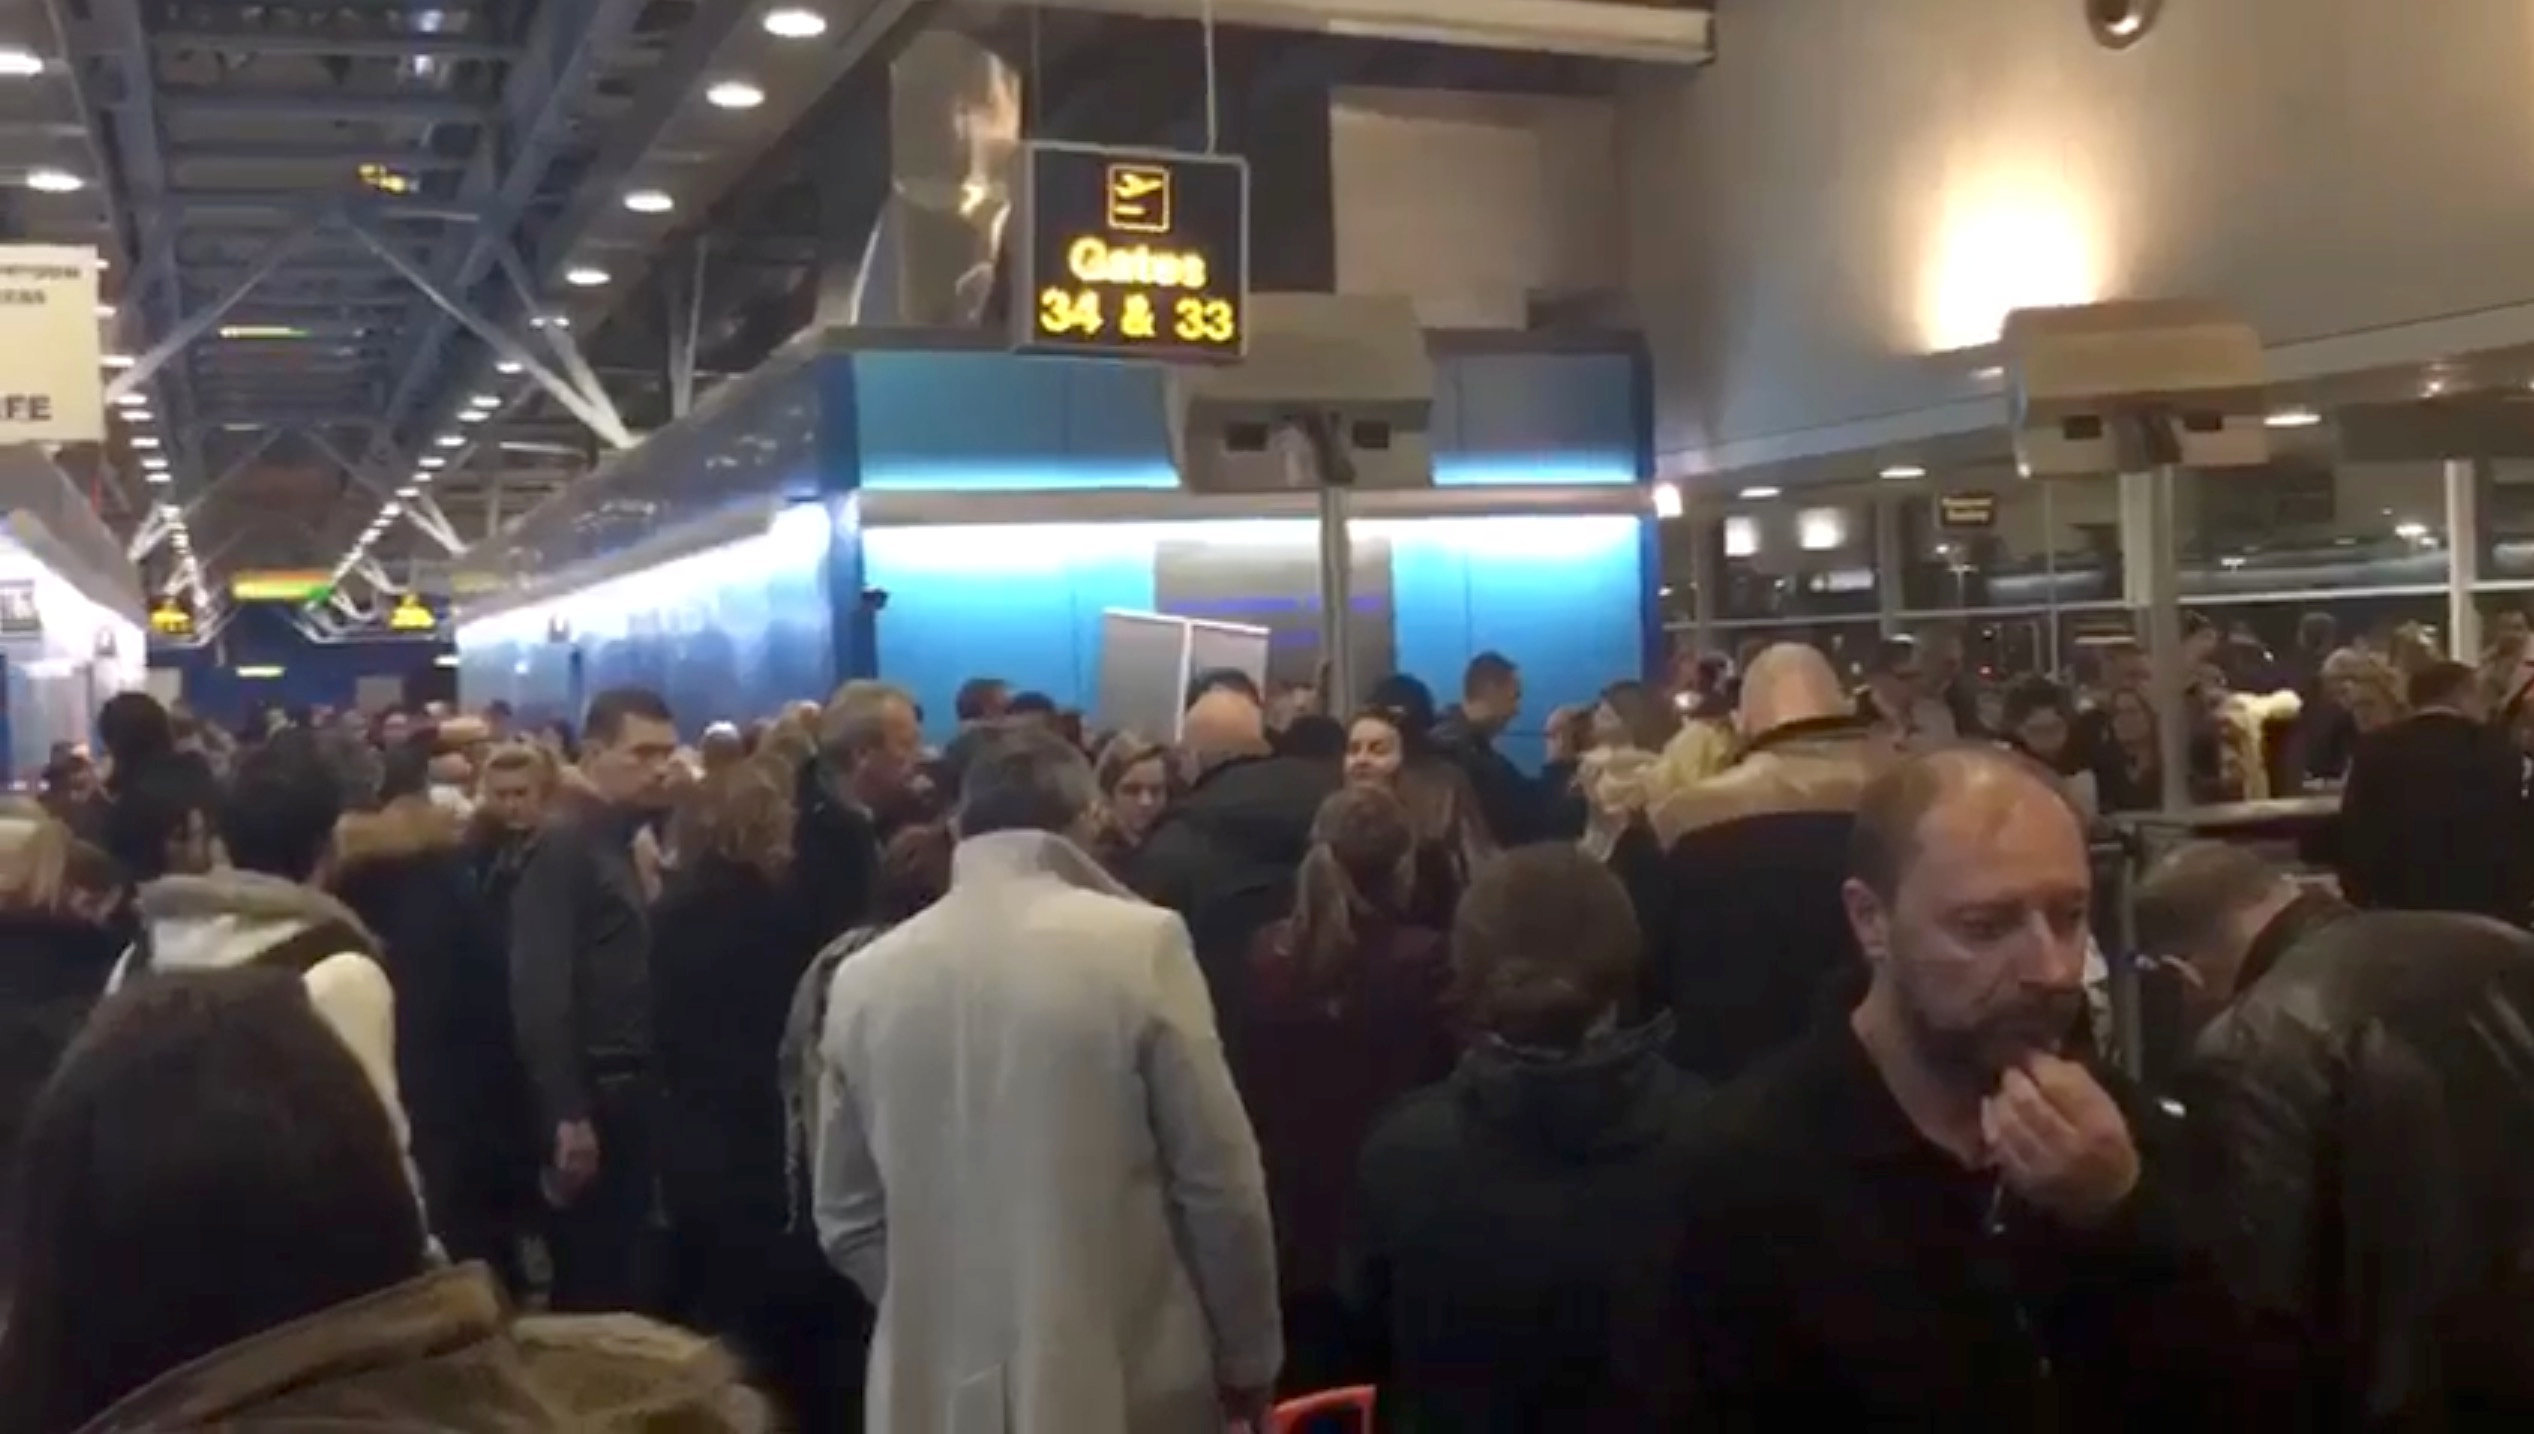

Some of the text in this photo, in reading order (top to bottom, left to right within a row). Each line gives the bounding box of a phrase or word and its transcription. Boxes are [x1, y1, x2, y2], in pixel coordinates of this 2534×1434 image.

[1068, 236, 1207, 289] Gates
[1040, 286, 1233, 341] 34 & 33
[0, 395, 52, 421] FE
